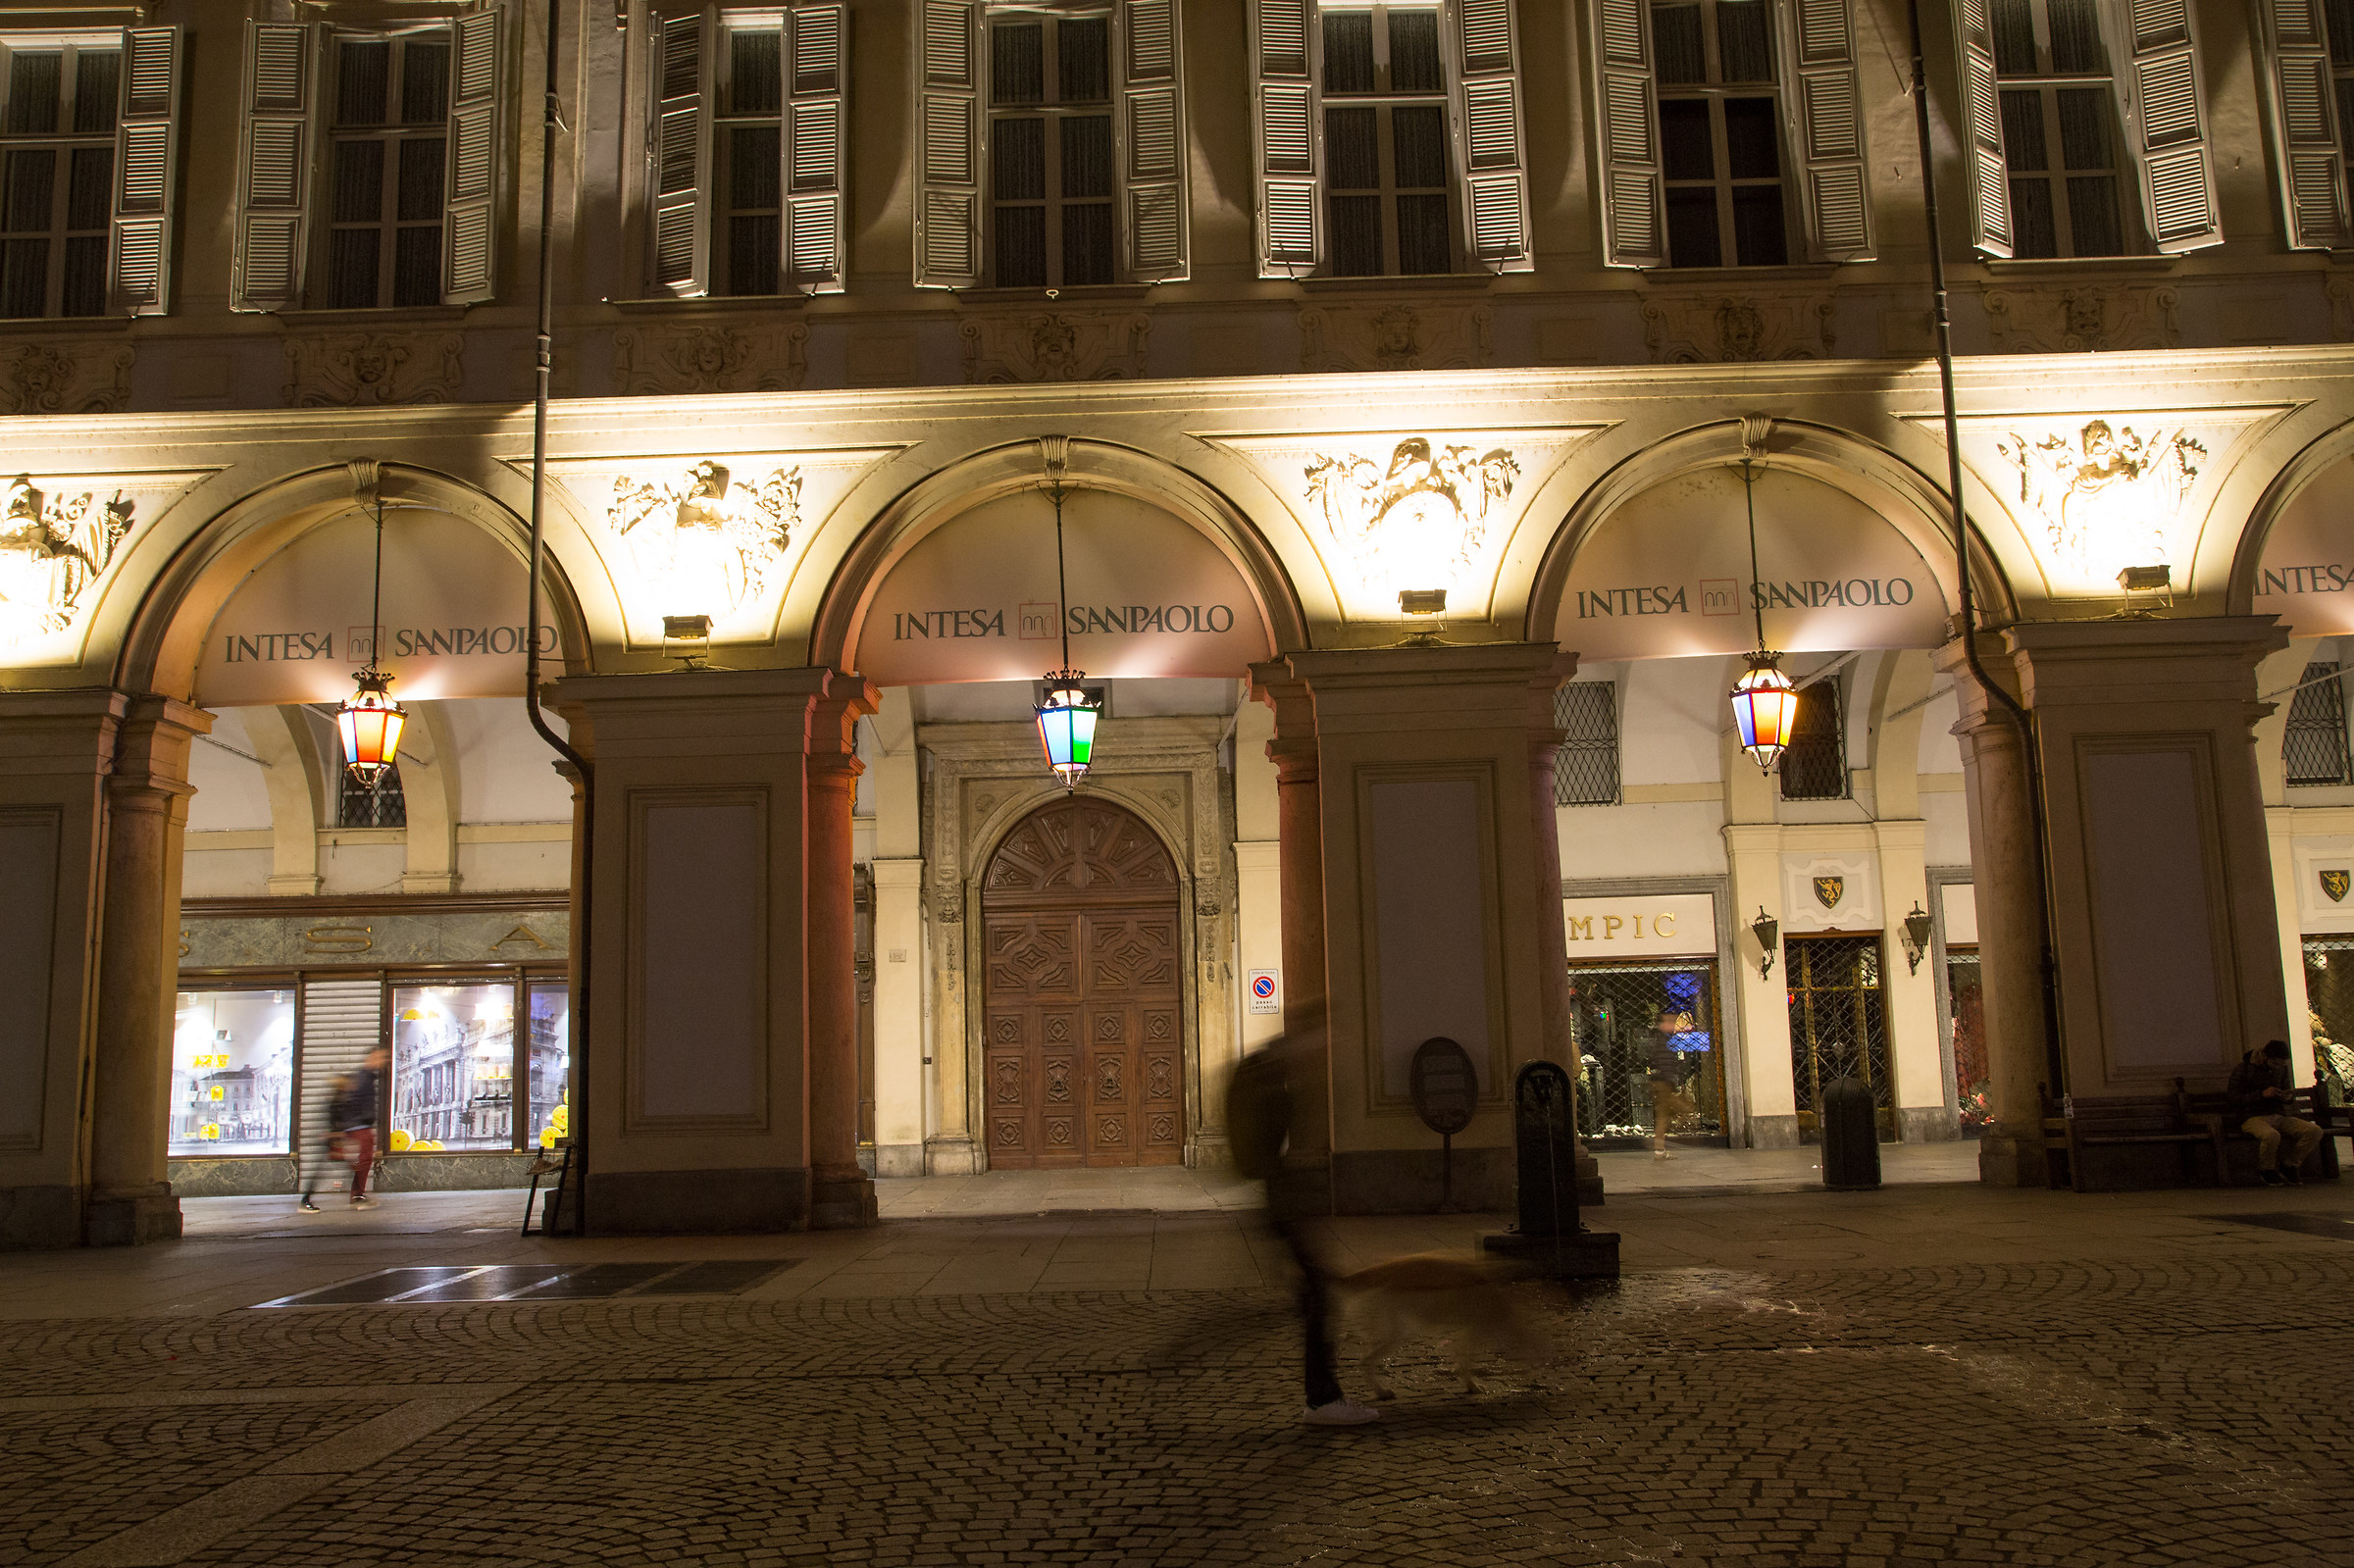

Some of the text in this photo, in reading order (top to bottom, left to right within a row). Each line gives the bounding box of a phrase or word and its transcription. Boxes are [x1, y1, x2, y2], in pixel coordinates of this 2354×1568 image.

[1575, 578, 1914, 619] INTESA SANPAOLO
[894, 604, 1234, 640] INTESA SANPAOLO
[224, 625, 558, 663] INTESA SANPAOLO
[1567, 912, 1676, 940] MPIC
